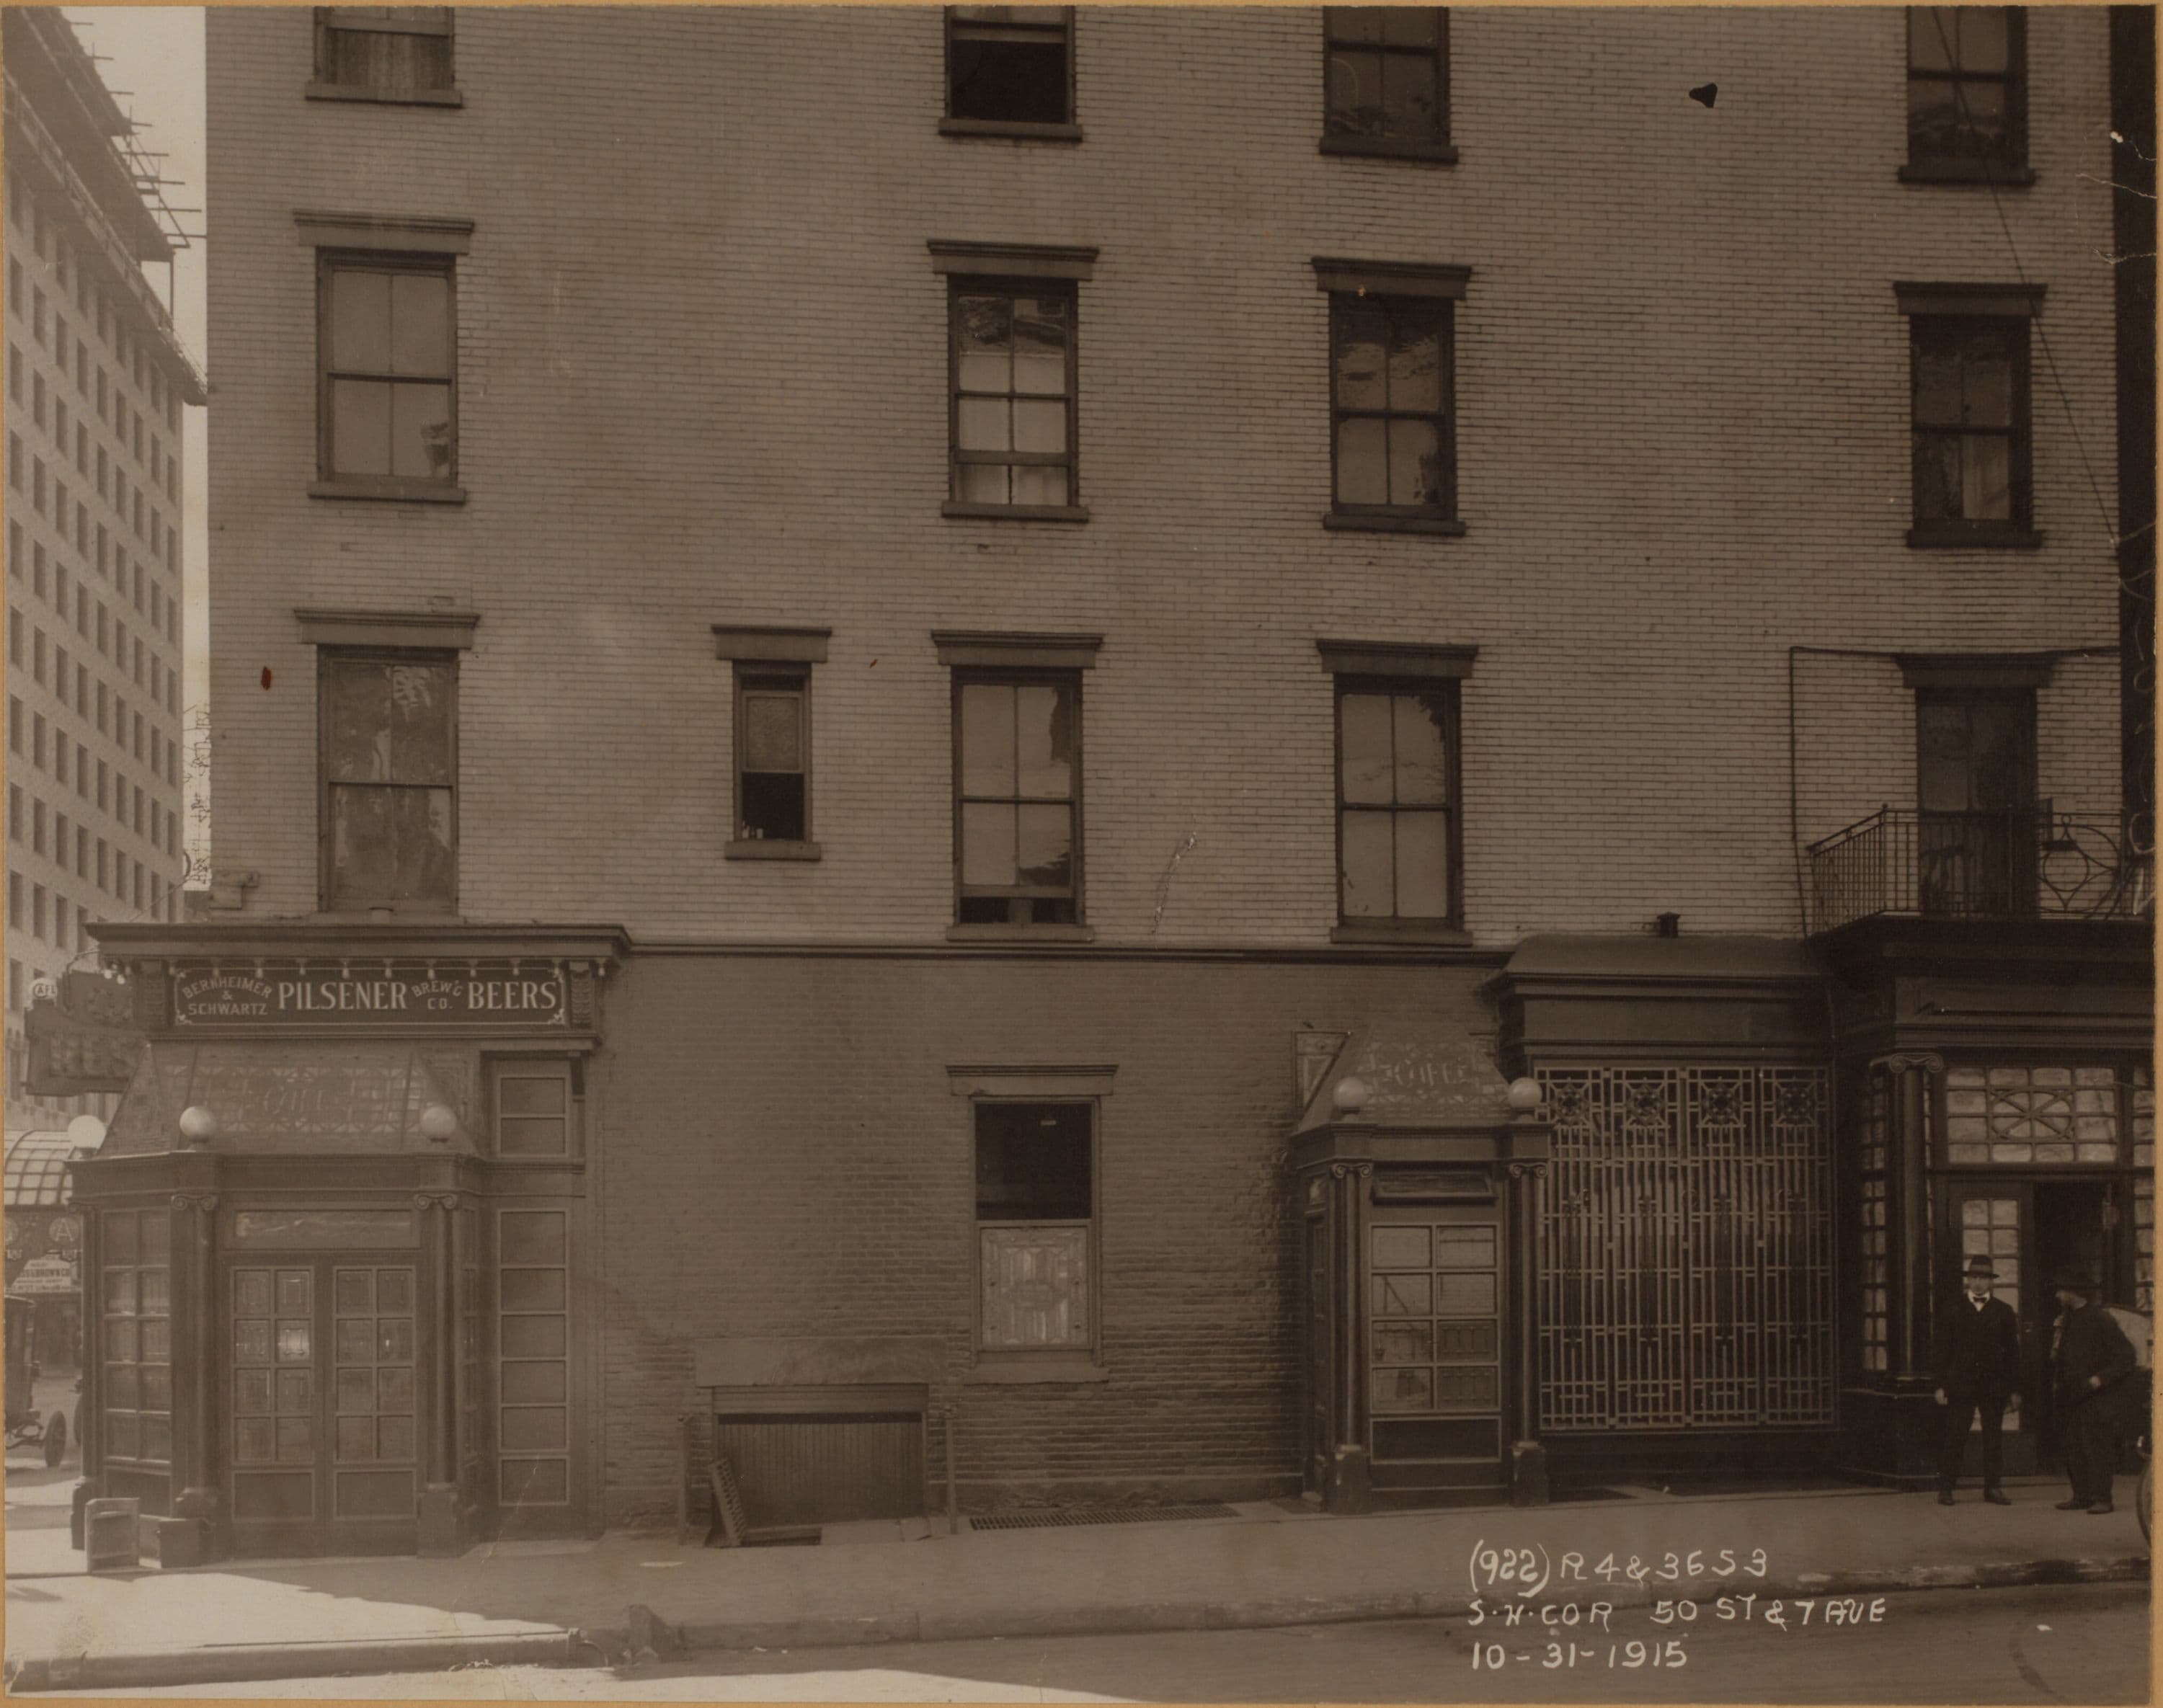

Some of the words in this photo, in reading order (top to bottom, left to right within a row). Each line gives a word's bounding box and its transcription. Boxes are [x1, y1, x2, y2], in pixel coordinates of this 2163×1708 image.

[182, 975, 272, 999] BERNHEIMER
[221, 989, 234, 1001] &
[278, 981, 408, 1010] PILSENER
[468, 981, 556, 1010] BEERS
[187, 1002, 268, 1015] SCHWARTZ
